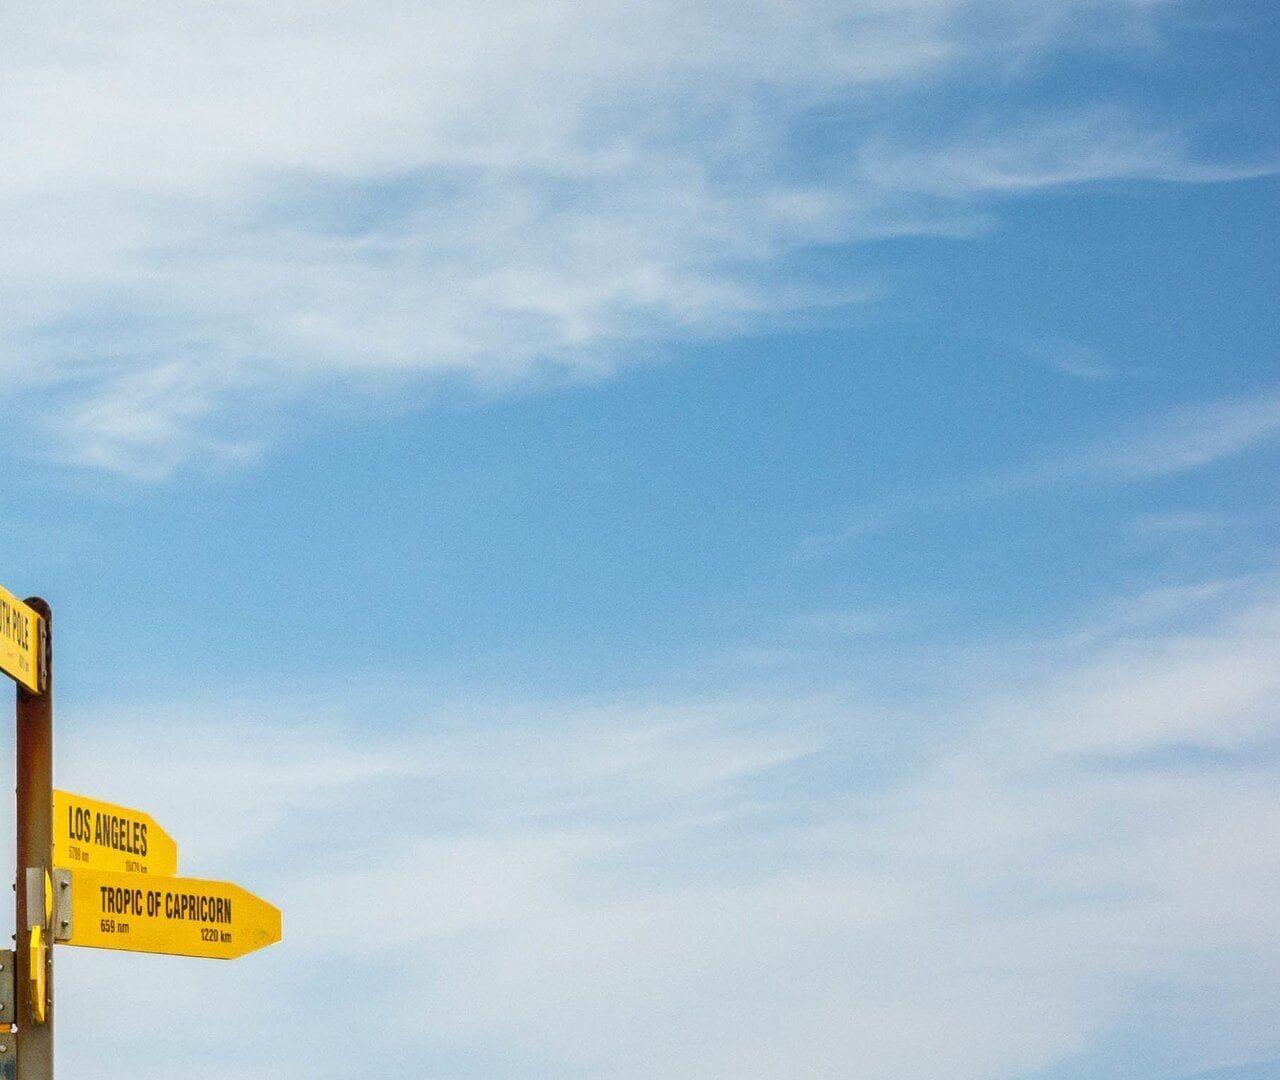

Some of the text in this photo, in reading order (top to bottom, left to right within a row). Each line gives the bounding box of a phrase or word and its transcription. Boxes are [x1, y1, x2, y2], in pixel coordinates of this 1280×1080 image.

[68, 805, 147, 857] LOS ANGELES
[100, 886, 231, 924] TROPIC OF CAPRICORN
[100, 919, 130, 933] 659 nm
[200, 927, 232, 943] 1220 km
